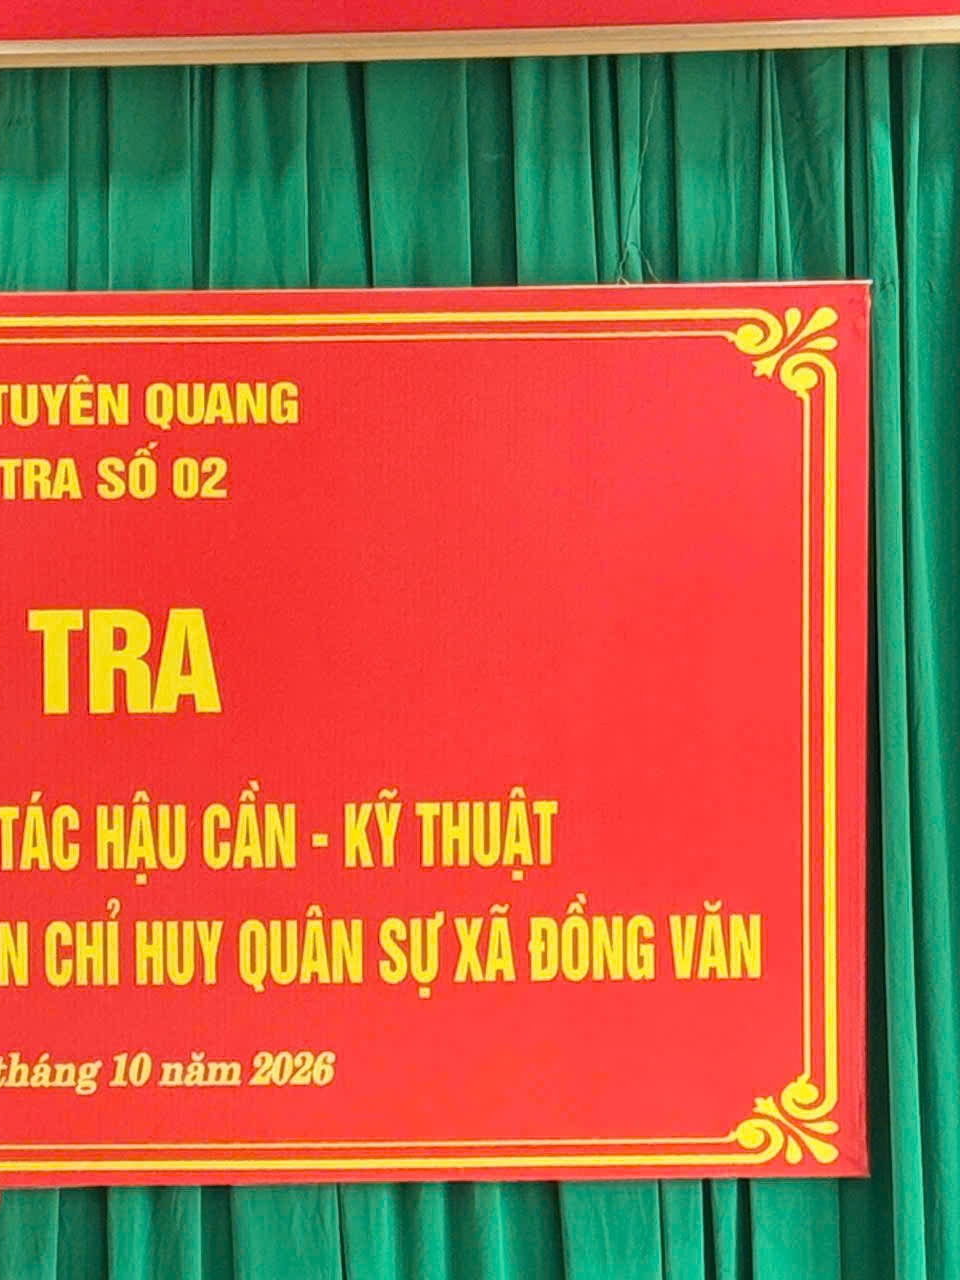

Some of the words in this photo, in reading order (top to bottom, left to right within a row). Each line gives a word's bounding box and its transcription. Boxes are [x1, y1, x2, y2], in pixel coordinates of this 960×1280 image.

[145, 381, 299, 431] QUANG
[97, 442, 157, 499] SỐ
[173, 456, 228, 499] 02
[28, 608, 222, 714] TRA
[96, 790, 187, 884] HẬU
[203, 780, 296, 870] CẦN
[312, 833, 328, 847] -
[344, 789, 402, 867] KỸ
[415, 786, 558, 881] THUẬT
[45, 898, 120, 987] CHỈ
[135, 920, 224, 986] HUY
[239, 905, 363, 993] QUÂN
[379, 911, 445, 998] SỰ
[454, 903, 516, 982] XÃ
[528, 893, 655, 982] ĐỒNG
[669, 900, 762, 979] VĂN
[109, 1052, 152, 1087] 10
[159, 1052, 241, 1087] năm
[249, 1051, 336, 1086] 2026
